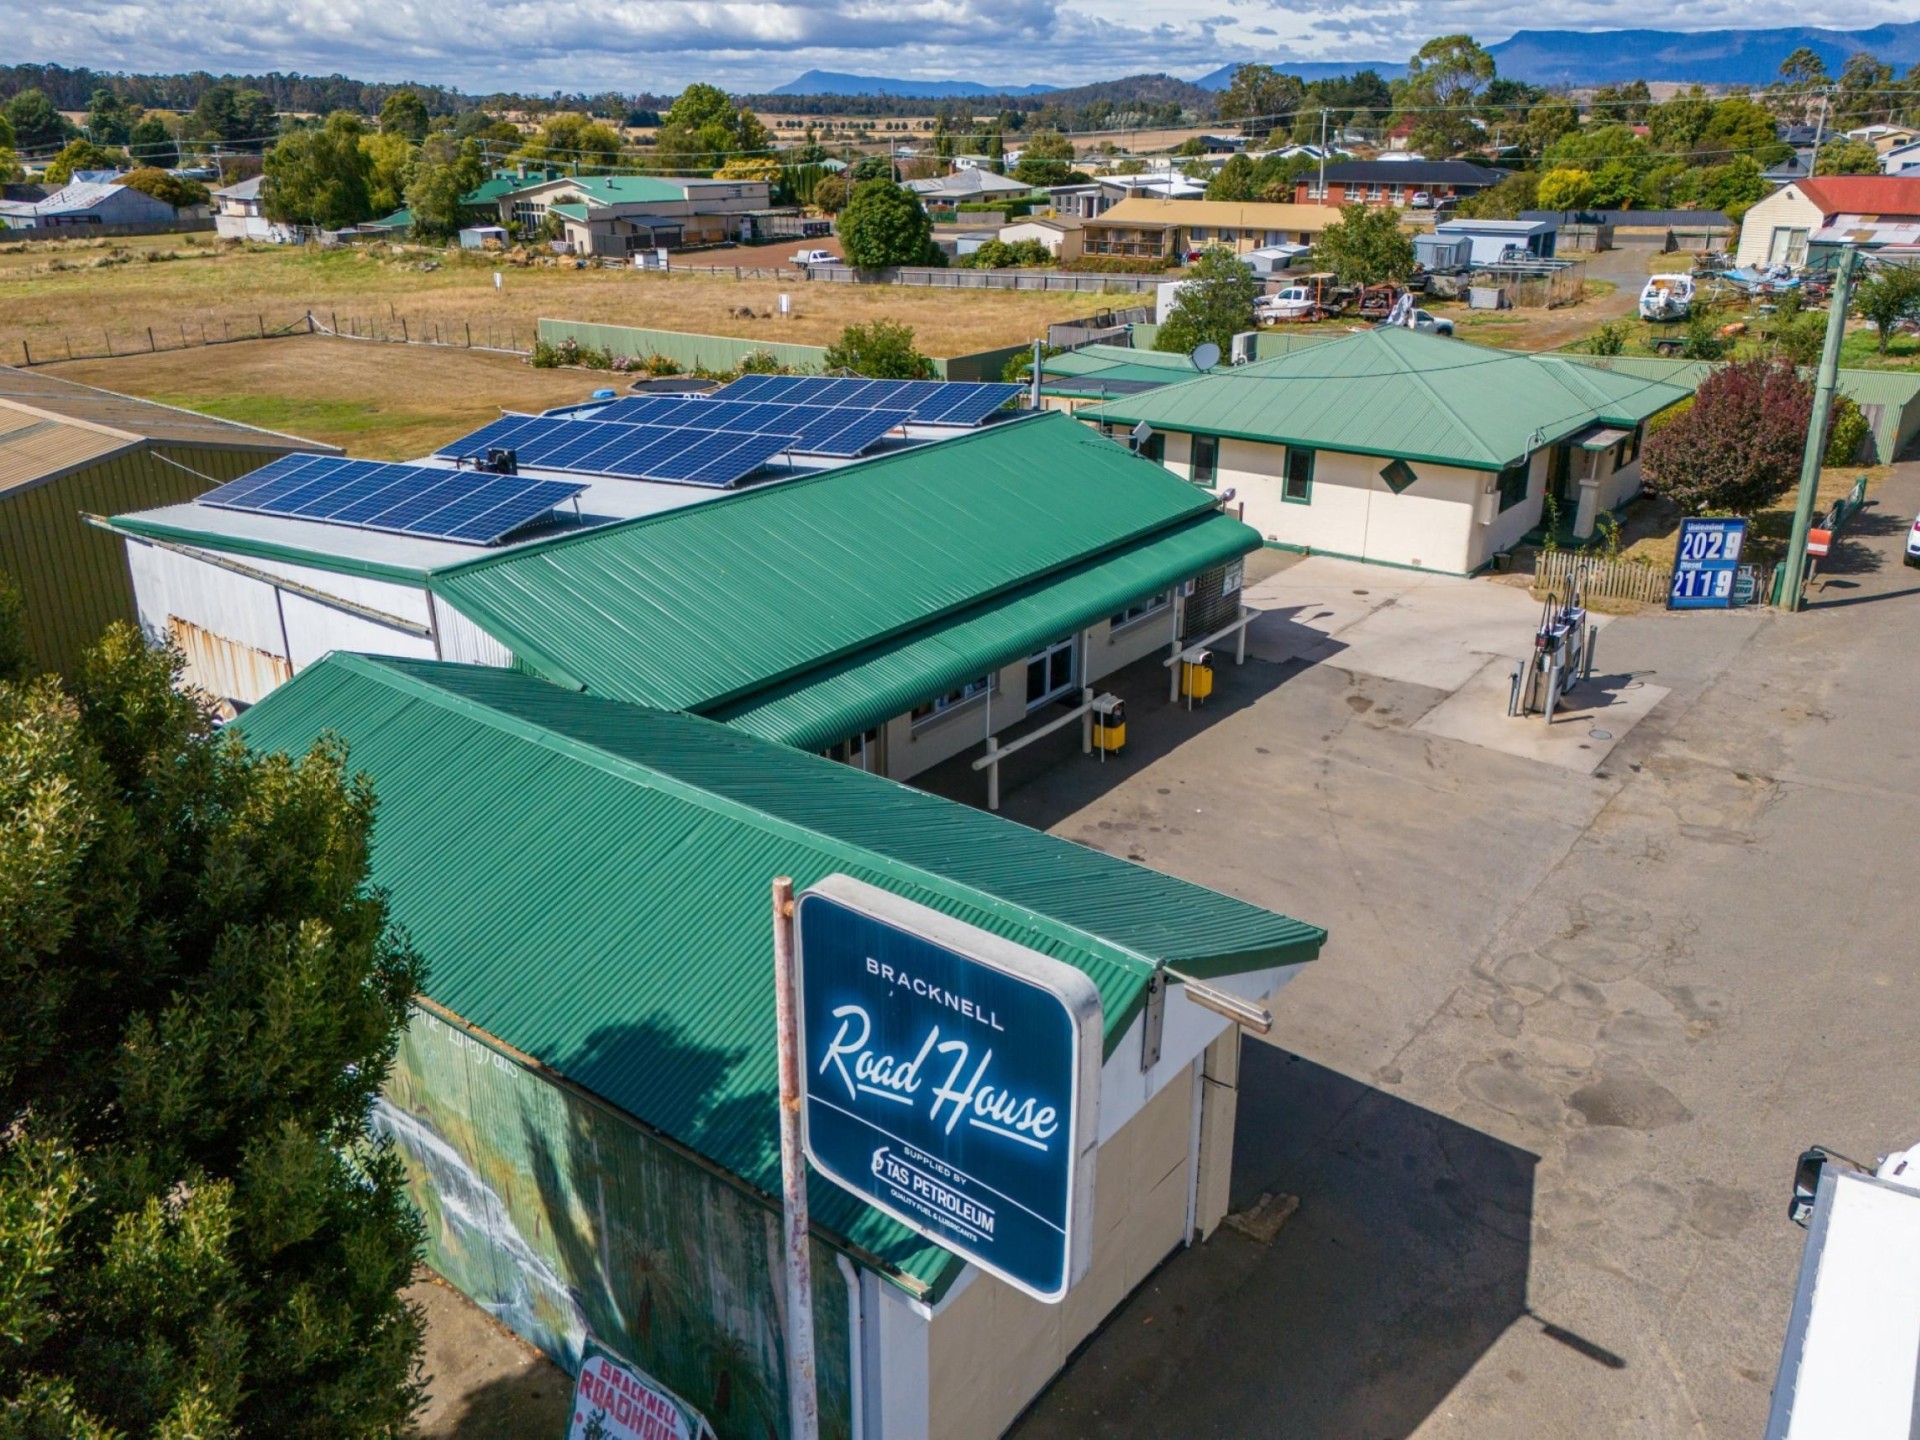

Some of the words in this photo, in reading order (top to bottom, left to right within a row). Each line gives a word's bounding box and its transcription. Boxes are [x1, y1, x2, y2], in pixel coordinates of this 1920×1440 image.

[1687, 522, 1724, 531] Unleaded
[866, 957, 1005, 1032] BRACKNELL
[819, 1005, 940, 1101] Road
[930, 1040, 1059, 1139] House
[886, 1159, 910, 1185] TAS
[913, 1175, 995, 1233] PETROLEUM
[903, 1146, 951, 1177] SUPPLIED
[953, 1173, 967, 1186] BY
[890, 1188, 917, 1208] QUALITY
[916, 1203, 932, 1218] FUEL
[938, 1215, 978, 1242] LUBRICANTS
[600, 1360, 677, 1428] BRACKNELL
